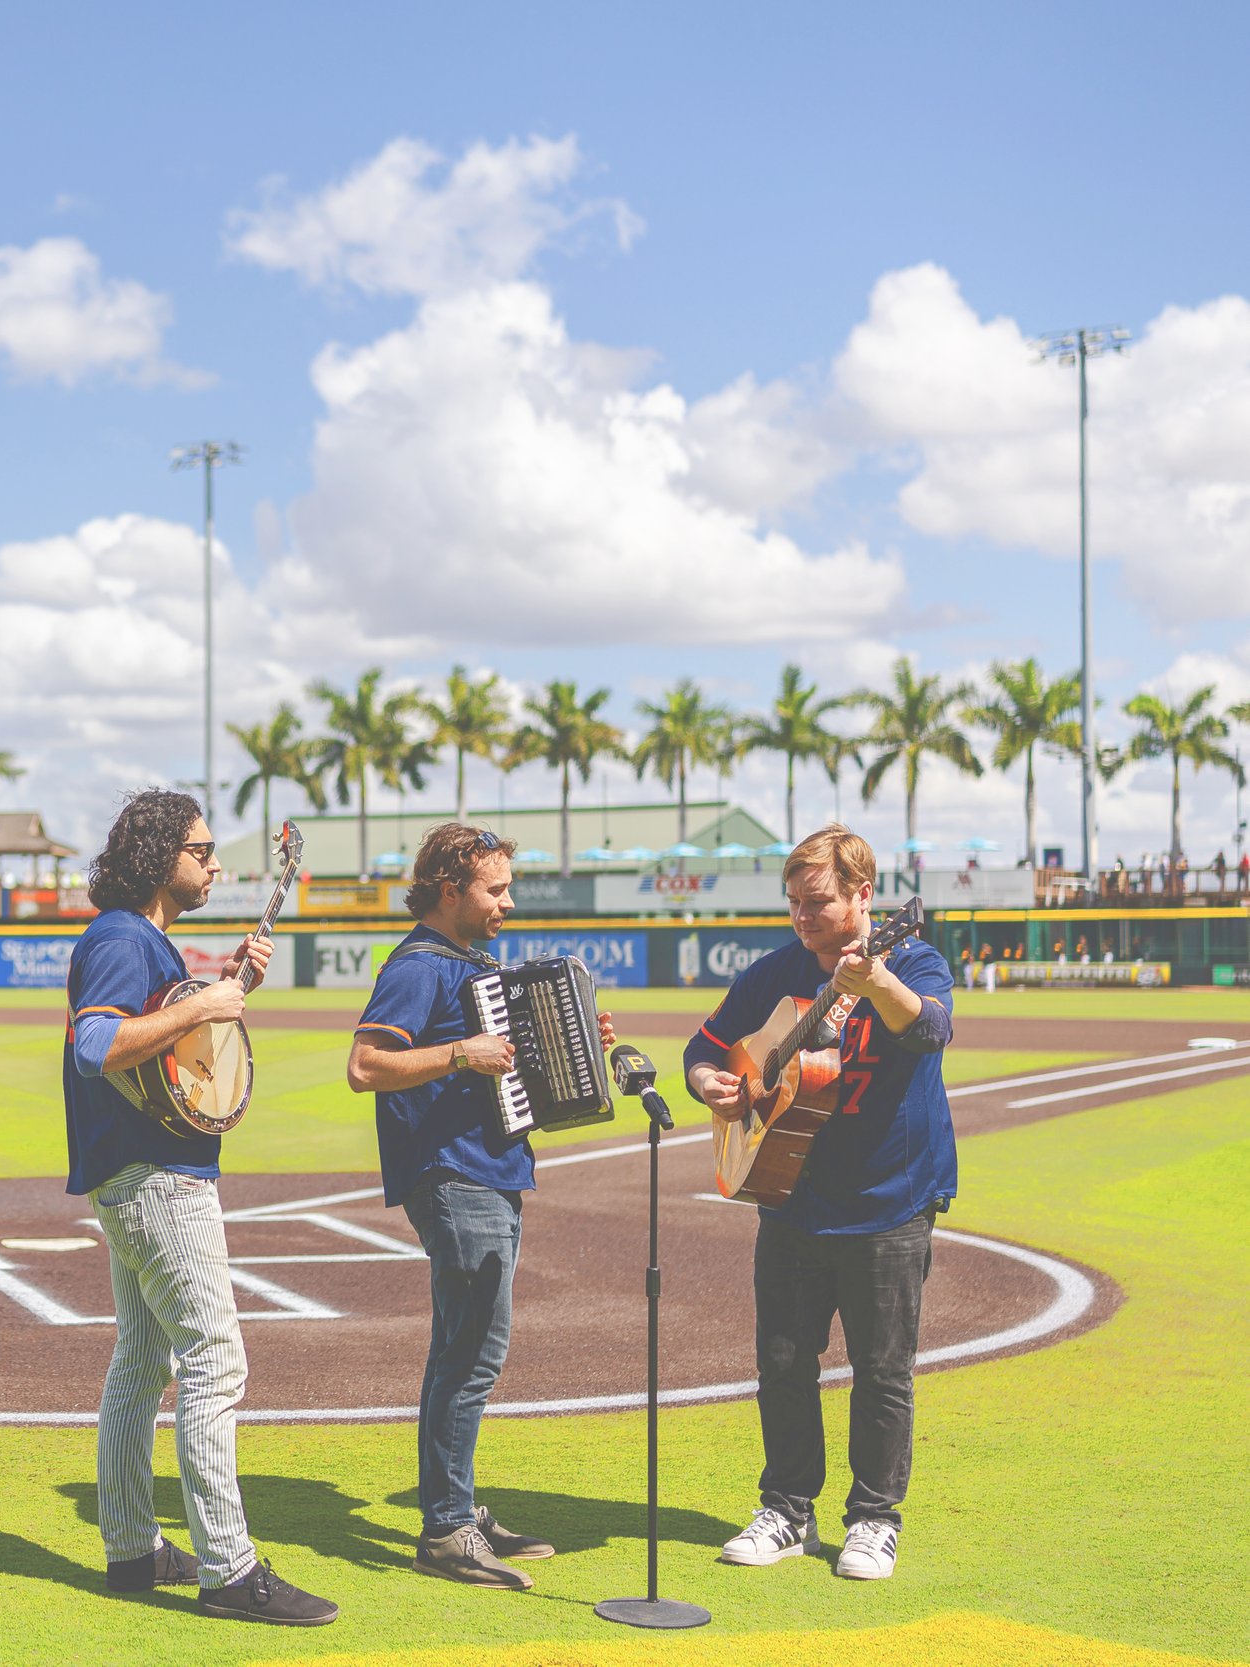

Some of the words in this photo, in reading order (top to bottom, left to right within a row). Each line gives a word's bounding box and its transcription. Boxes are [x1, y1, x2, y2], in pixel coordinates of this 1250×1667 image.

[655, 874, 702, 894] COX
[317, 947, 367, 975] FLY
[707, 940, 774, 978] Cor
[626, 1056, 645, 1071] P
